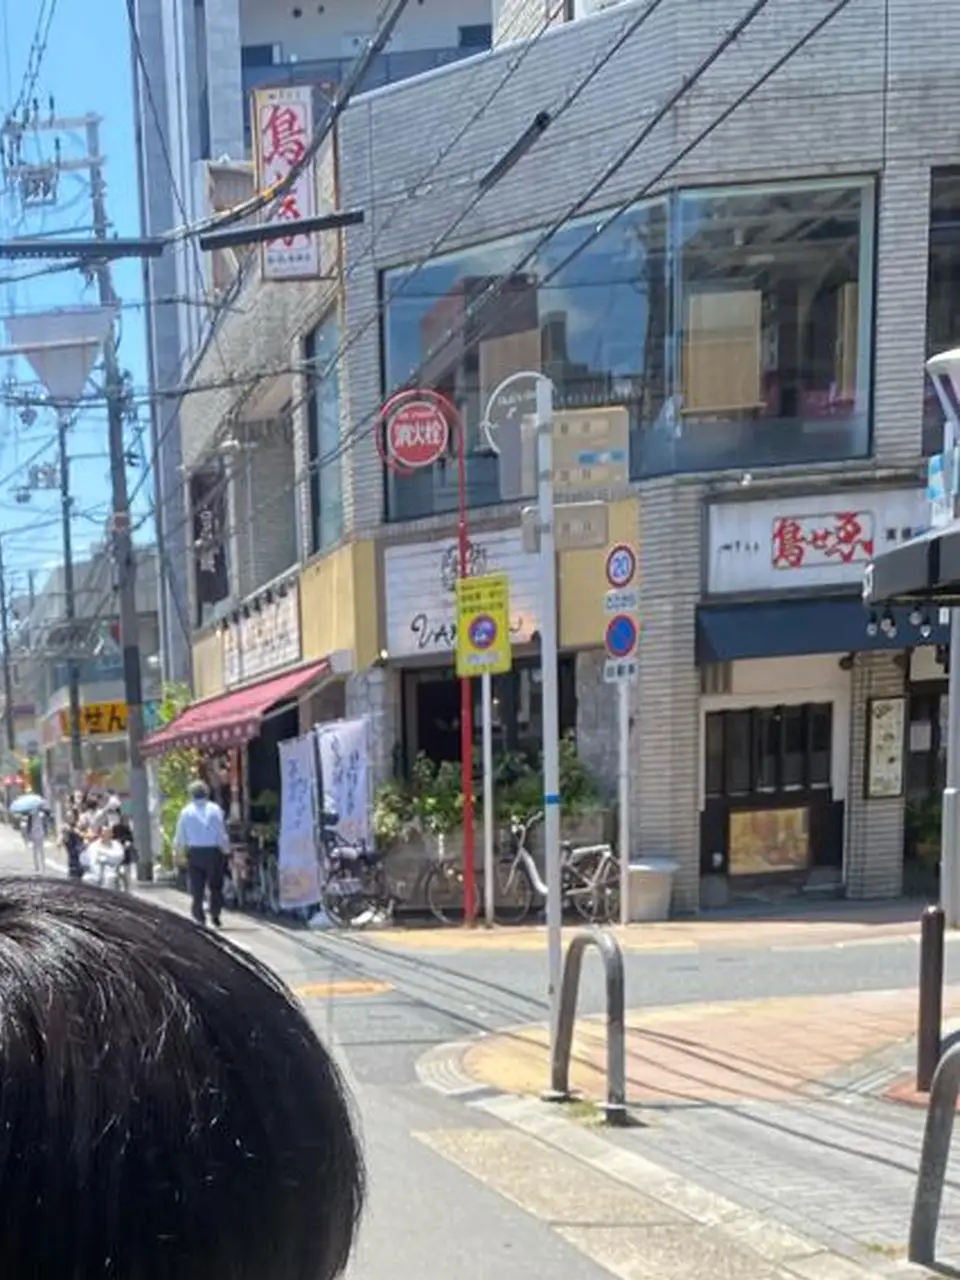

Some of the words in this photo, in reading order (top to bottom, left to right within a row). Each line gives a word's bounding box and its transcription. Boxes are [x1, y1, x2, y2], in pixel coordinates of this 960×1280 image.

[394, 420, 441, 448] 消火栓
[612, 556, 629, 578] 20
